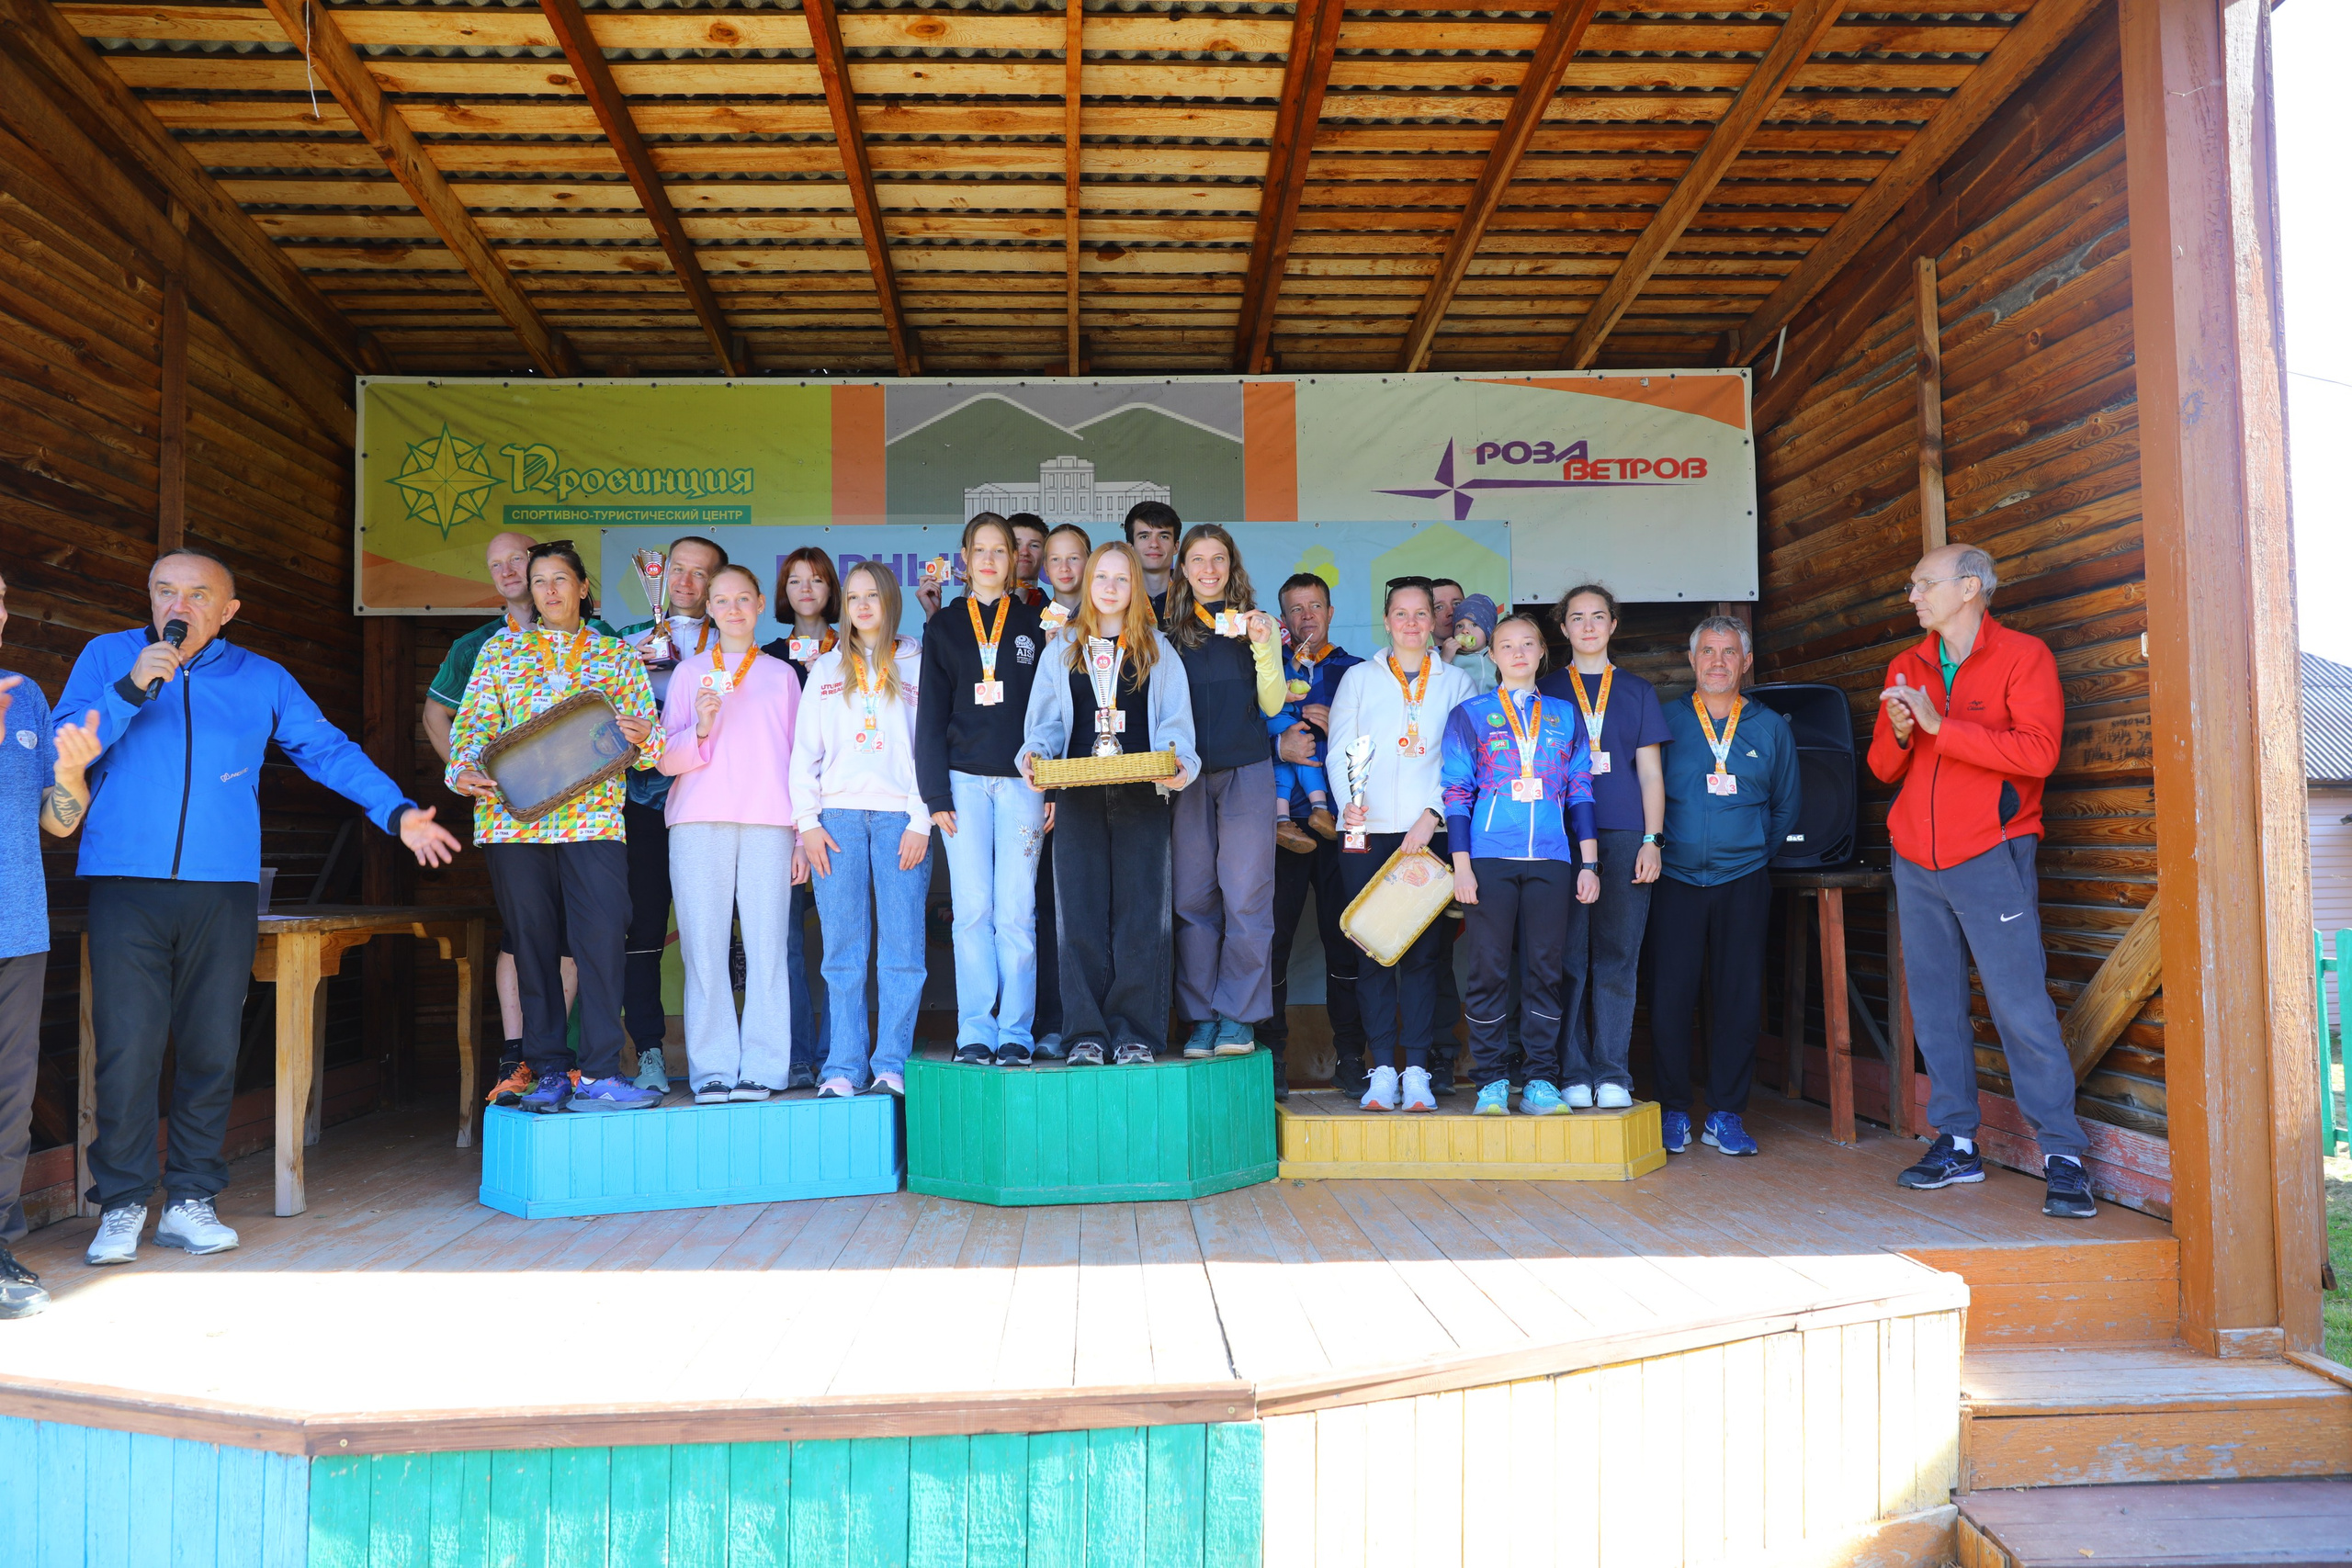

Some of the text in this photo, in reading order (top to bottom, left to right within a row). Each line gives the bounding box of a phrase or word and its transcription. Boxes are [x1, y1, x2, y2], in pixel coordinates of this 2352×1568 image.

[1476, 440, 1589, 465] РОЗА
[499, 443, 754, 503] Провинция
[1563, 457, 1708, 480] ВЕТРОВ
[512, 508, 743, 523] СПОРТИВНО-ТУРИСТИЧЕСКИЙ ЦЕНТР
[945, 570, 949, 579] 1
[725, 681, 733, 691] 2
[996, 691, 1001, 700] 1
[1118, 720, 1124, 730] 1
[876, 740, 883, 750] 2
[1418, 746, 1425, 755] 3
[1602, 762, 1610, 771] 3
[1728, 784, 1736, 792] 3
[1534, 789, 1542, 798] 3
